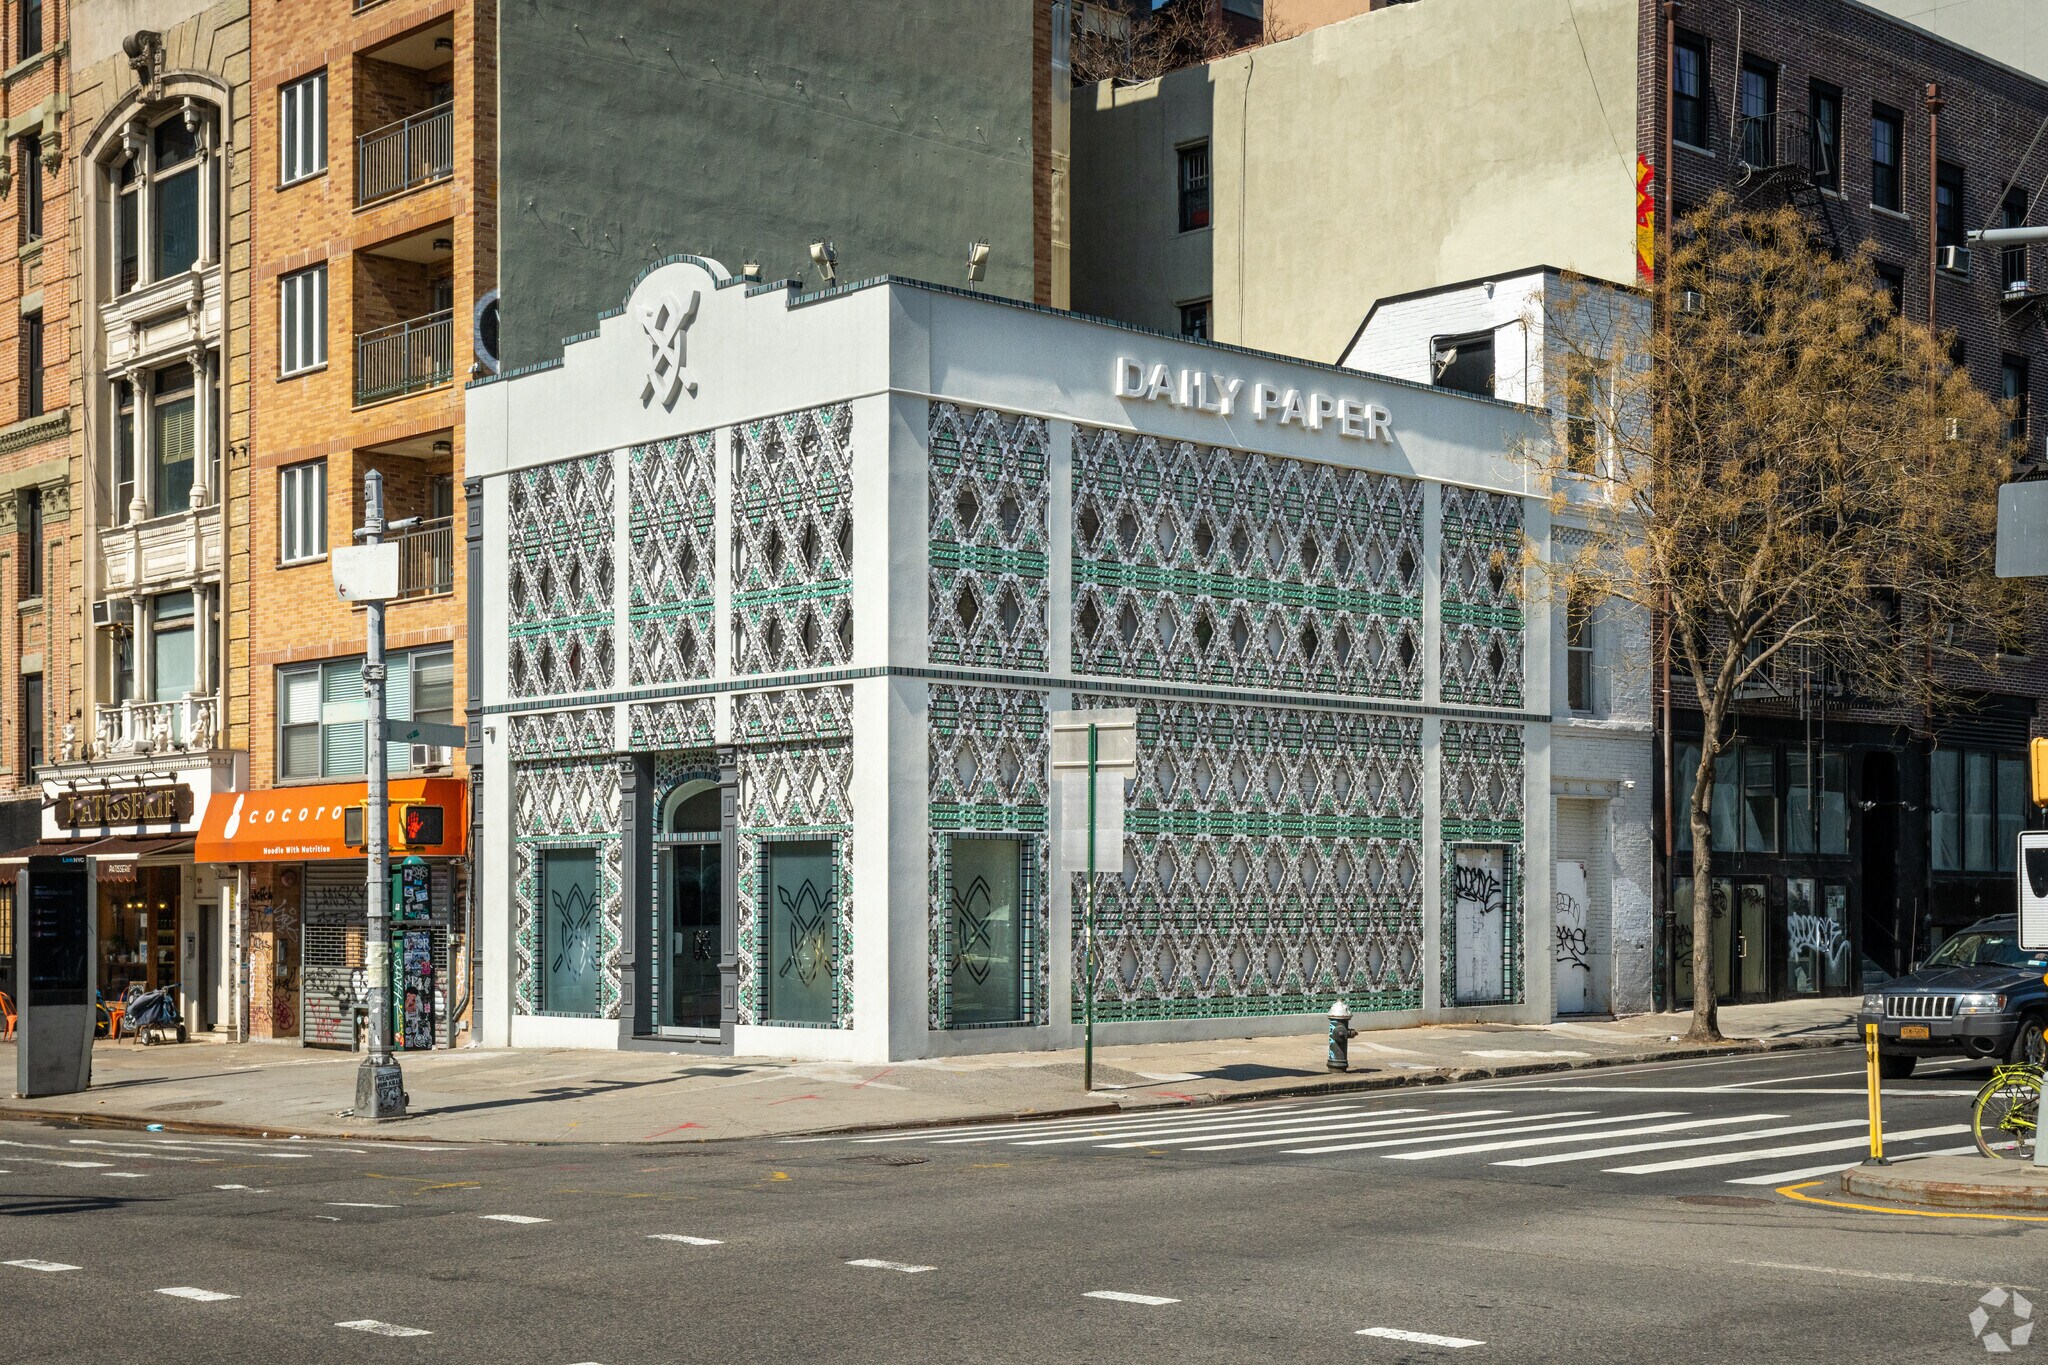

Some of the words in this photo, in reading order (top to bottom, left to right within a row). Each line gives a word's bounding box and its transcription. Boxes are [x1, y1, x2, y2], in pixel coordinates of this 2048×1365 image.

[1115, 357, 1245, 415] DAILY
[1254, 383, 1394, 443] PAPER
[249, 806, 342, 824] cocoro
[263, 846, 284, 855] Noodle
[285, 845, 300, 854] With
[301, 844, 331, 853] Nutrition
[108, 864, 132, 873] PATISSERIE
